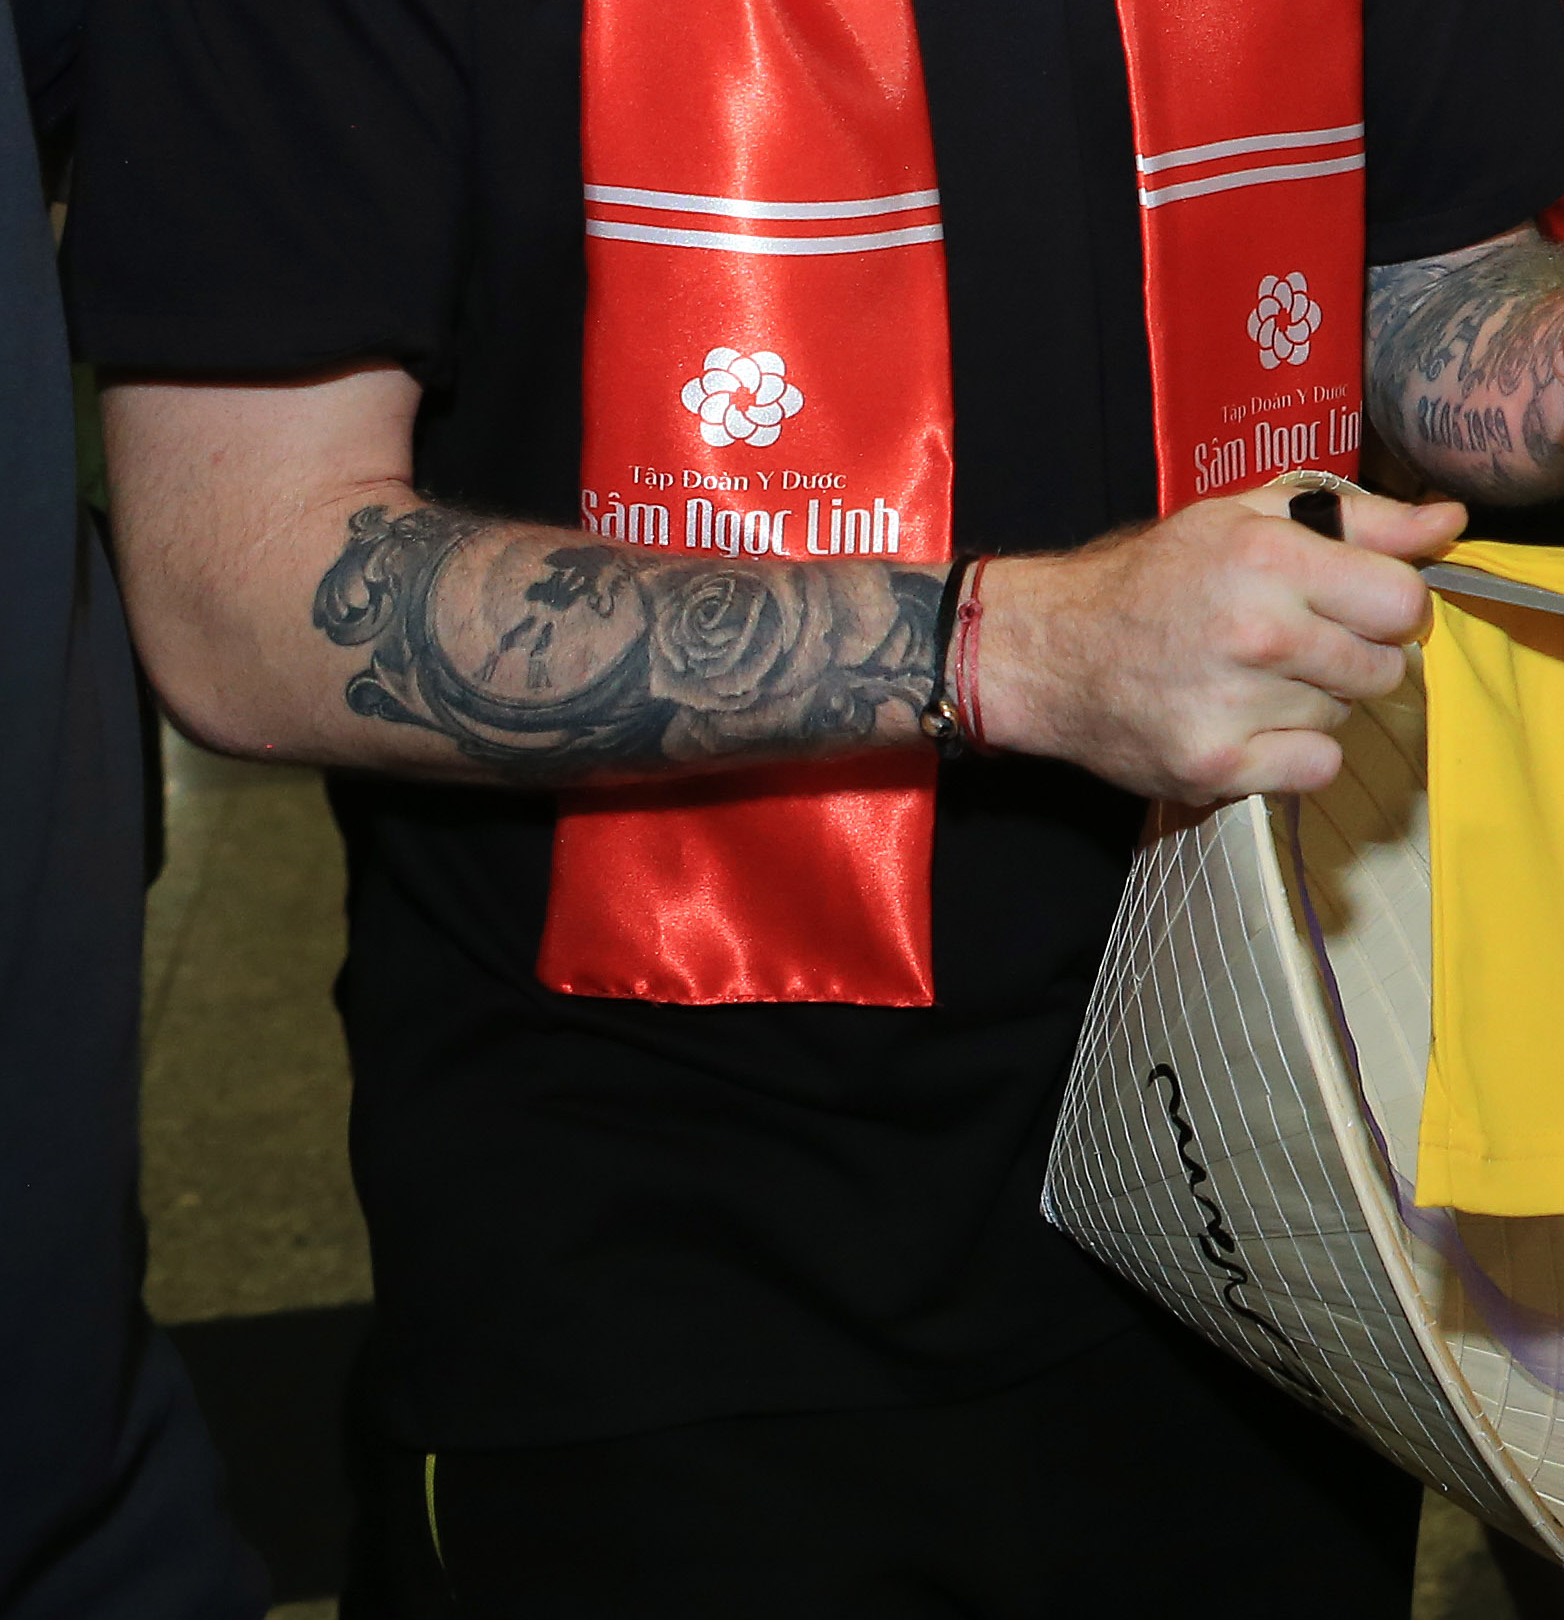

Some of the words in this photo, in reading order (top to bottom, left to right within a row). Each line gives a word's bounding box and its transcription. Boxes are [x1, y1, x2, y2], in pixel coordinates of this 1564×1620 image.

[1296, 388, 1309, 406] Y
[1193, 436, 1247, 495] Sâm
[1254, 421, 1321, 475] Ngọc
[1328, 400, 1364, 456] Lin
[628, 465, 675, 491] Tập
[682, 469, 749, 491] Đoàn
[756, 471, 776, 490] Y
[782, 469, 847, 493] Dược
[581, 489, 669, 547] Sâm
[686, 497, 793, 560] Ngọc
[806, 497, 900, 556] Linh
